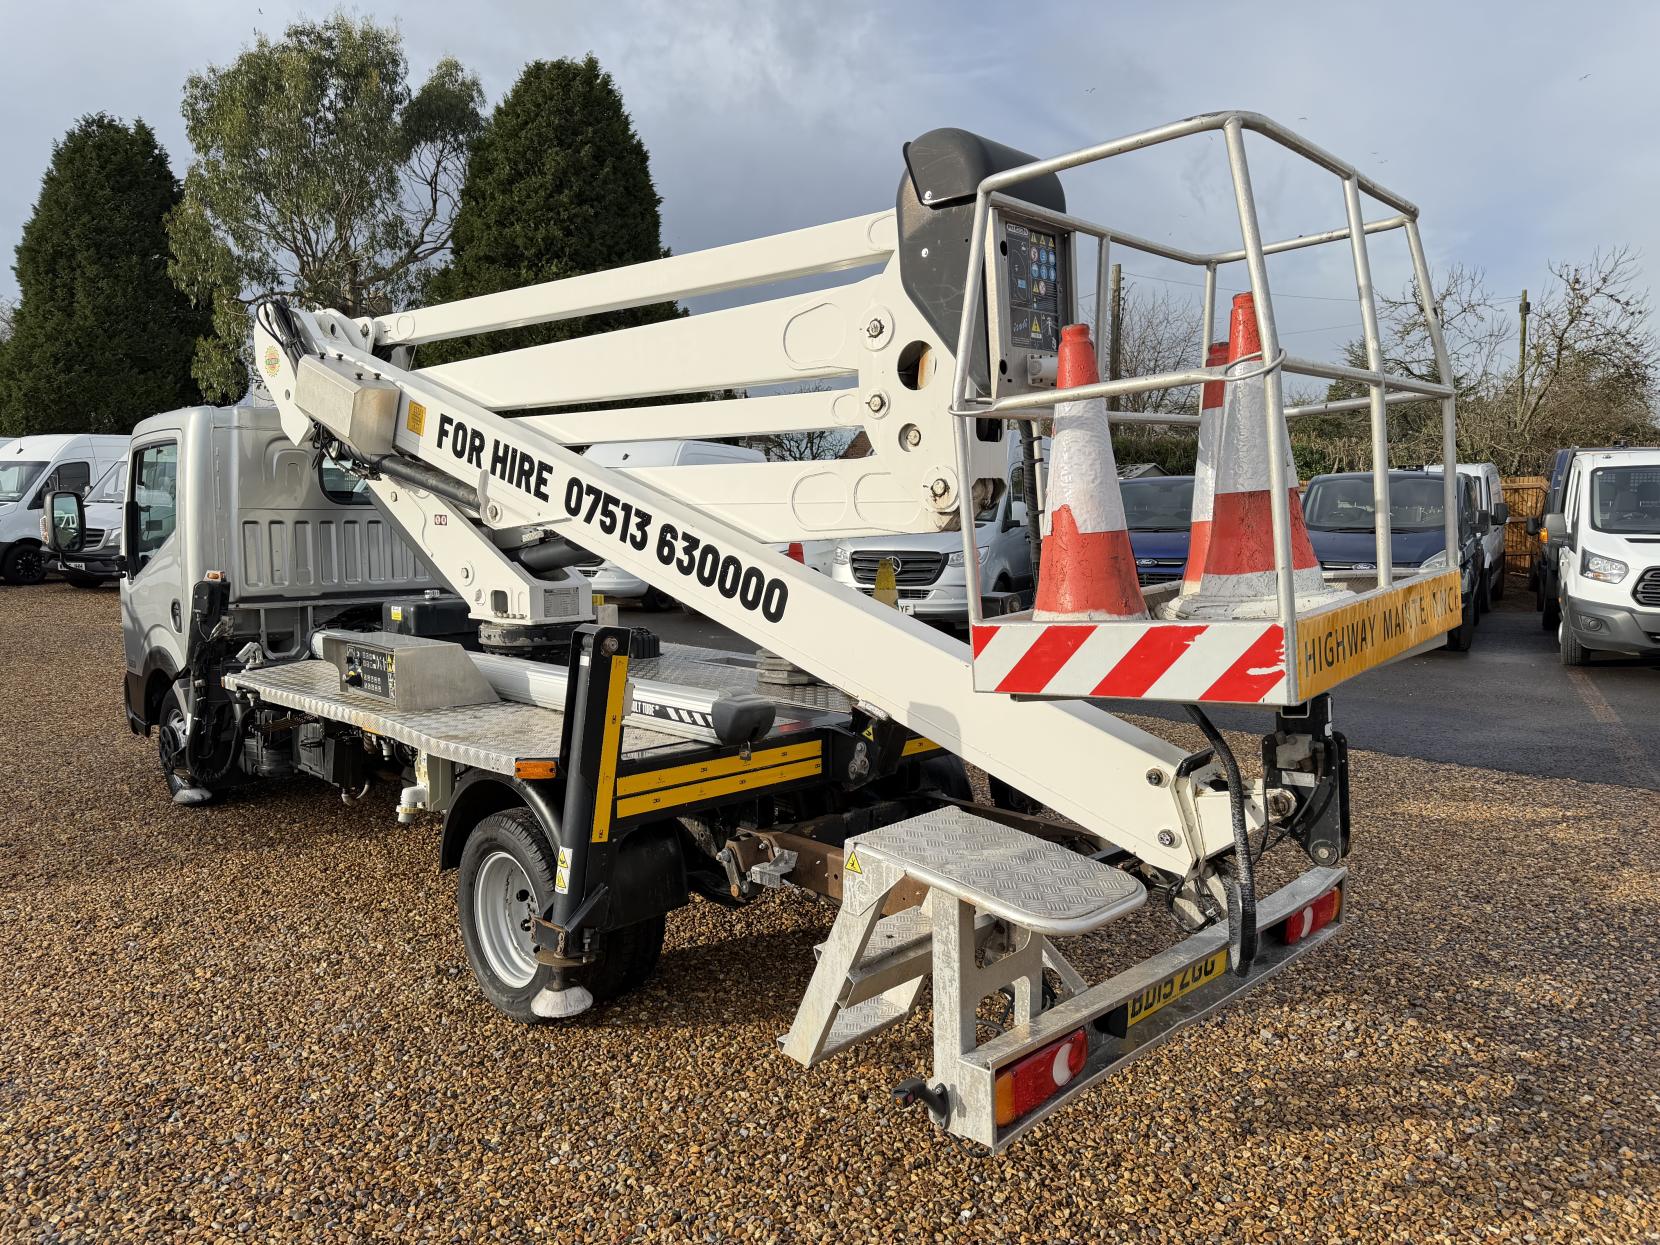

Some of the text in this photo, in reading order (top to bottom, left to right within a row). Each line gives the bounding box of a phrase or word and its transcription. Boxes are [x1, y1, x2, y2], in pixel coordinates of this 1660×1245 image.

[437, 413, 486, 470] FOR
[490, 438, 554, 503] HIRE
[564, 476, 653, 551] 07513
[656, 523, 789, 624] 630000
[1304, 586, 1460, 678] HIGHWAY MAINTENCE
